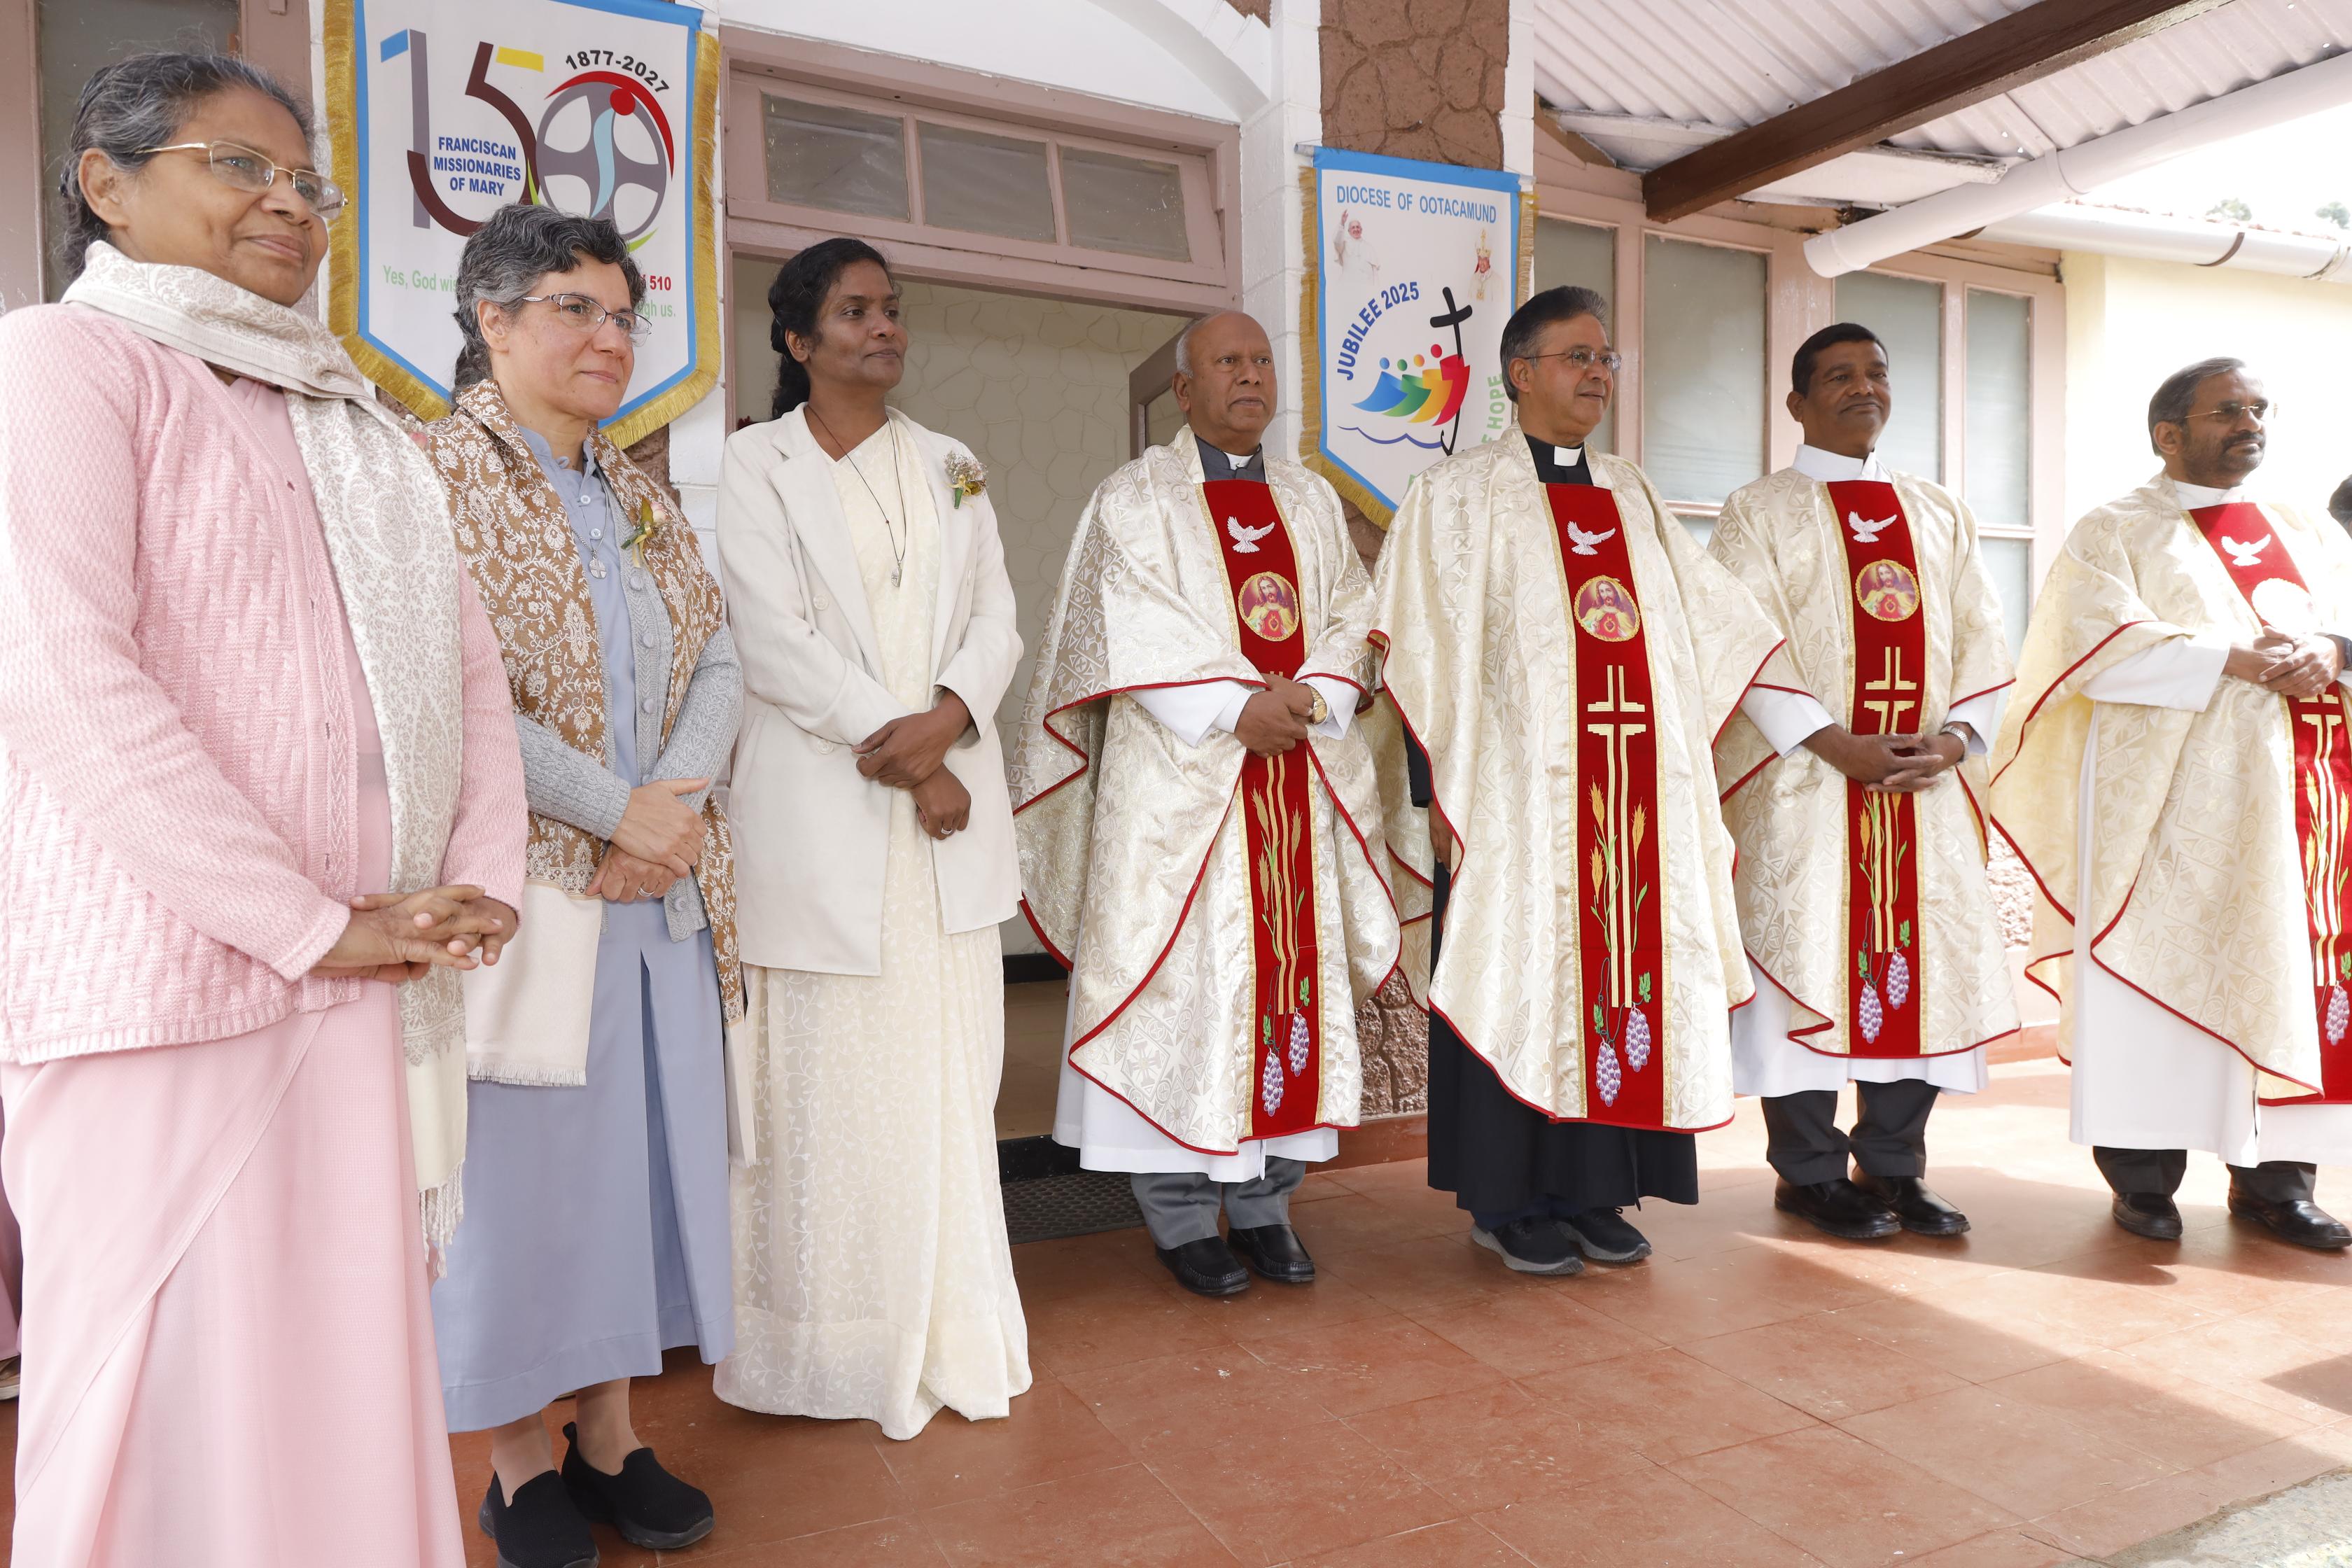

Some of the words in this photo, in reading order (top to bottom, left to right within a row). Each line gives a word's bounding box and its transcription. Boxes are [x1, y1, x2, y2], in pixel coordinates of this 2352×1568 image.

[566, 50, 670, 92] 1877-2027
[438, 136, 516, 160] FRANCISCAN
[434, 156, 521, 181] MISSIONARIES
[449, 177, 465, 191] OF
[469, 178, 505, 196] MARY
[1336, 186, 1391, 208] DIOCESE
[1397, 192, 1413, 211] OF
[1420, 195, 1497, 223] OOTACAMUND
[383, 265, 407, 289] Yes,
[412, 270, 436, 290] God
[650, 275, 671, 290] 510
[660, 304, 676, 317] us.
[1337, 298, 1382, 381] JUBILEE
[1381, 281, 1420, 309] 2025
[1487, 374, 1505, 429] HOPE
